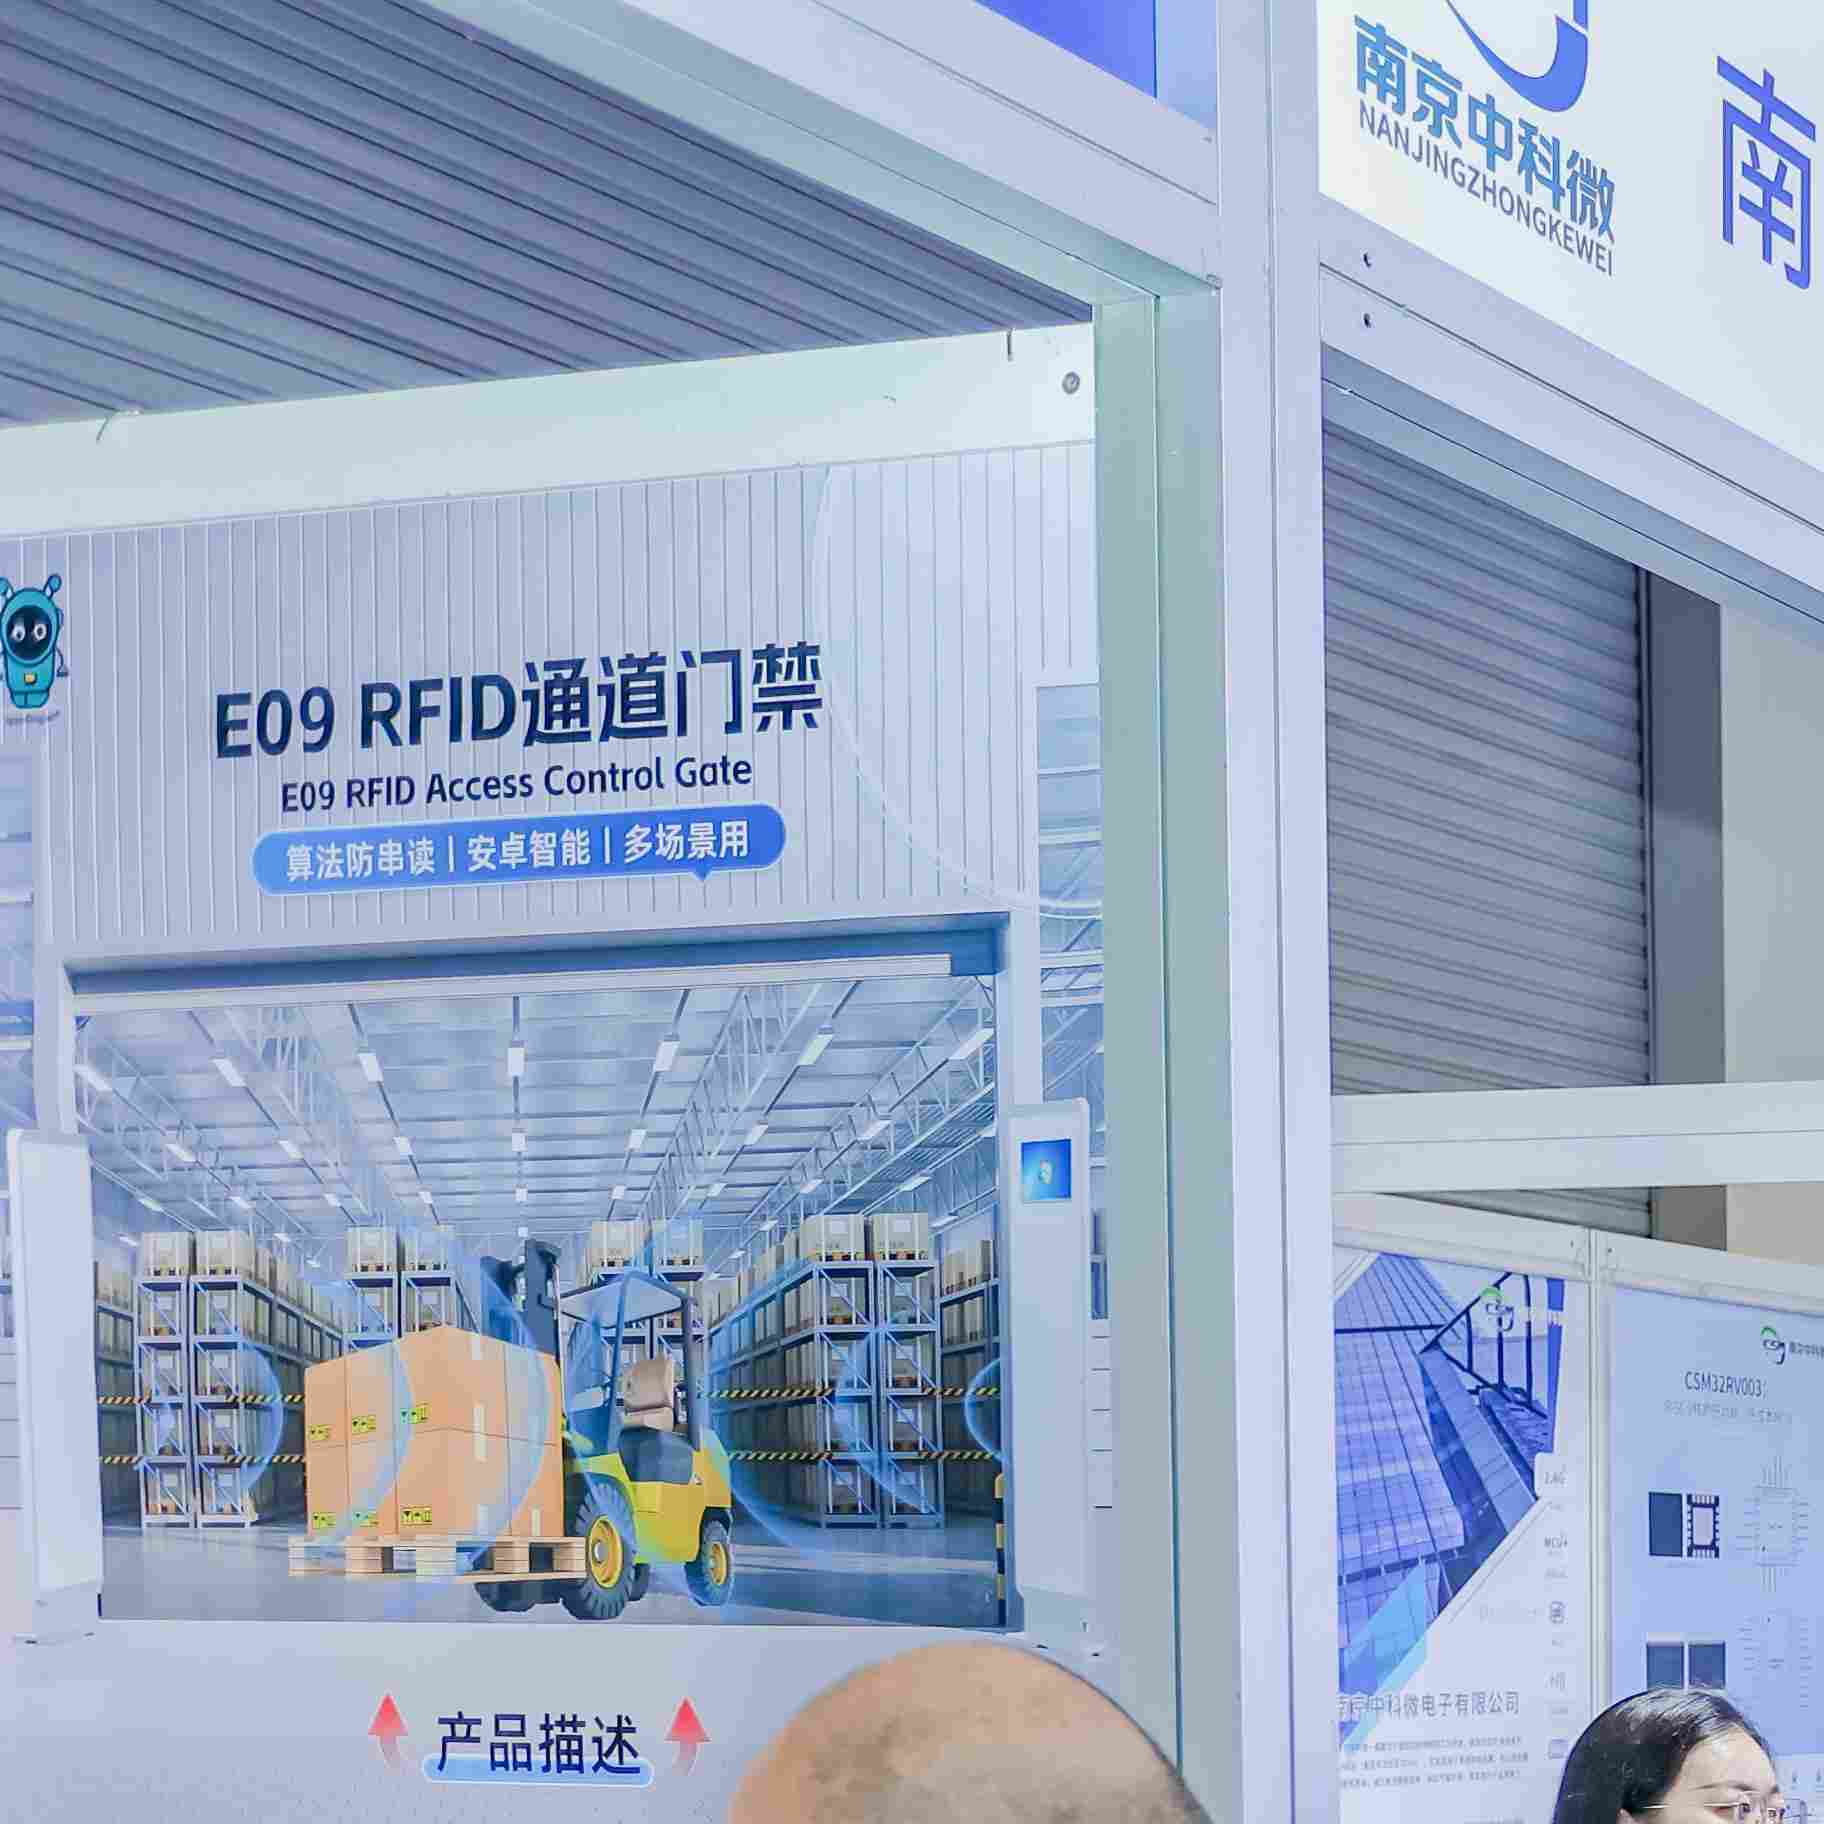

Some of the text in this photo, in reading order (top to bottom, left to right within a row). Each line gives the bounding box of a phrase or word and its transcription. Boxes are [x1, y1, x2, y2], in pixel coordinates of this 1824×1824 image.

[1353, 14, 1616, 244] 南京中科微
[1359, 104, 1613, 277] NANJINGZHONGKEWEI
[215, 640, 825, 760] E09 RFID通道门禁
[281, 752, 753, 813] E09 RFID Access Control Gate
[286, 819, 751, 882] 算法防串读 安卓智能 多场景用
[436, 1710, 642, 1775] 产品描述
